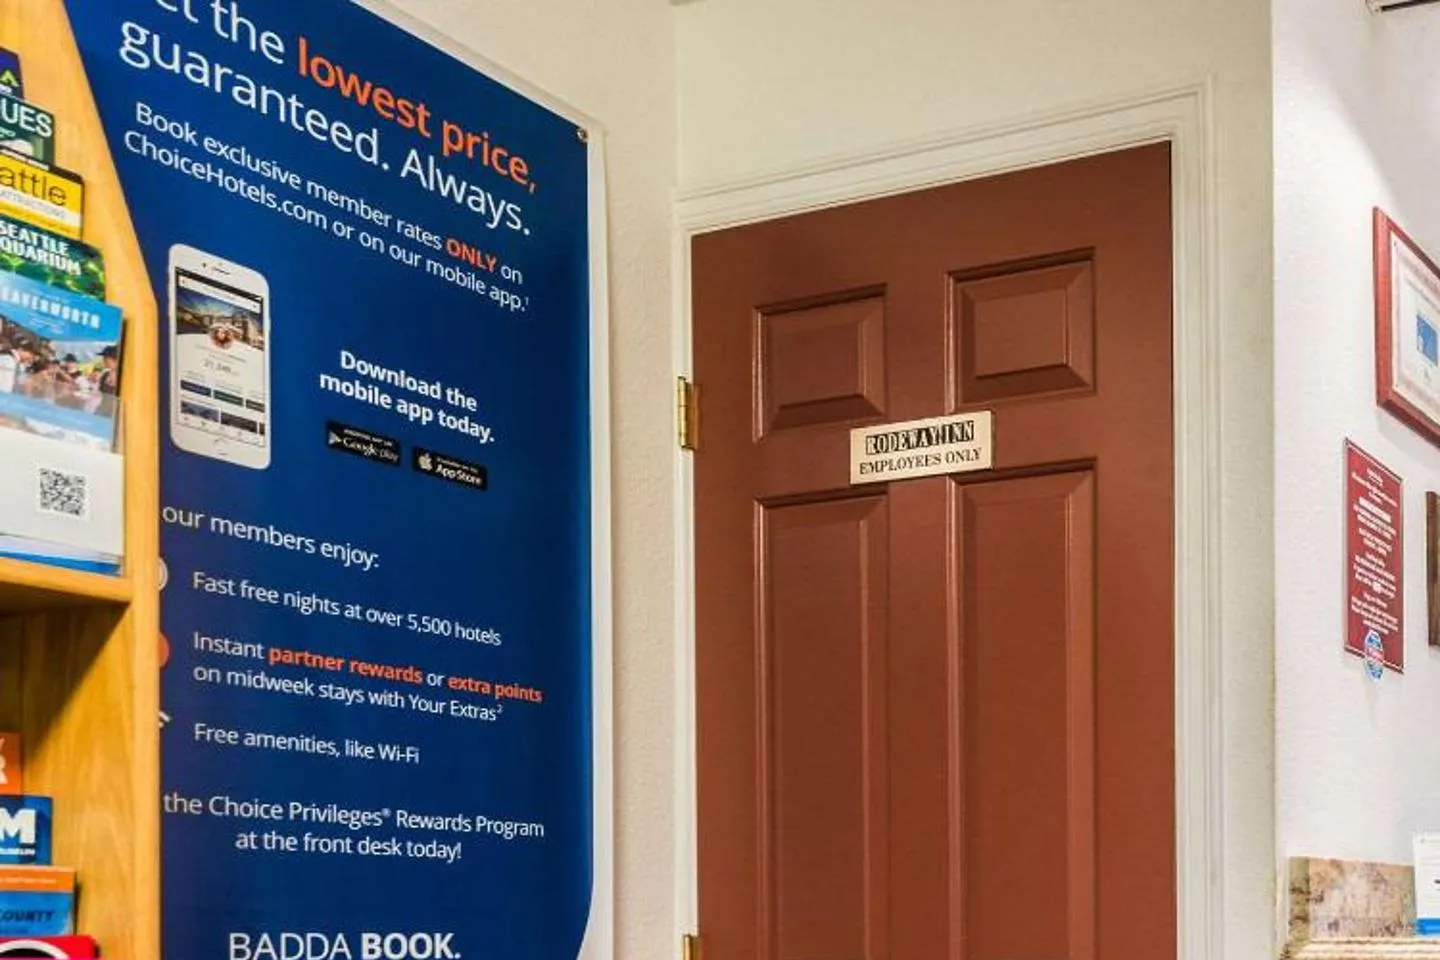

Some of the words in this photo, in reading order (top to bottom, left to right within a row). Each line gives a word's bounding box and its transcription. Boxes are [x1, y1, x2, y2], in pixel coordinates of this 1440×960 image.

[119, 20, 390, 171] guaranteed.
[401, 149, 532, 235] Always.
[210, 0, 286, 64] the
[298, 36, 431, 138] lowest
[442, 119, 538, 194] price,
[124, 130, 328, 232] ChoiceHotels.com
[333, 220, 355, 240] or
[359, 231, 385, 254] on
[389, 243, 422, 268] our
[425, 257, 486, 295] mobile
[136, 101, 198, 147] Book
[203, 136, 302, 191] exclusive
[306, 179, 392, 228] member
[397, 218, 442, 250] rates
[446, 237, 497, 272] ONLY
[501, 263, 523, 285] on
[319, 373, 392, 408] mobile
[396, 399, 433, 425] app
[438, 409, 495, 444] today.
[340, 350, 441, 400] Download
[446, 387, 477, 411] the
[860, 452, 941, 475] EMPLOYEES
[945, 447, 982, 464] ONLY
[865, 425, 941, 455] RODEWAY
[942, 420, 974, 444] INN
[163, 506, 205, 528] our
[210, 515, 315, 554] members
[320, 541, 380, 571] enjoy:
[193, 571, 236, 597] Fast
[240, 579, 279, 604] free
[283, 590, 340, 616] nights
[344, 604, 362, 619] at
[365, 608, 403, 627] over
[407, 613, 452, 637] 5,500
[454, 622, 502, 646] hotels
[193, 631, 265, 660] Instant
[268, 647, 345, 671] partner
[349, 658, 423, 684] rewards
[426, 671, 445, 687] or
[448, 675, 491, 694] extra
[495, 682, 543, 703] points
[193, 666, 221, 683] on
[226, 670, 314, 696] midweek
[318, 683, 364, 705] stays
[368, 689, 404, 708] with
[408, 694, 446, 715] Your
[194, 723, 238, 745] Free
[244, 731, 341, 757] amenities,
[345, 738, 375, 760] like
[377, 743, 420, 764] Wi-Fi
[163, 792, 203, 815] the
[209, 796, 283, 819] Choice
[396, 809, 471, 832] Rewards
[475, 815, 545, 840] Program
[235, 832, 258, 850] at
[263, 830, 298, 851] the
[303, 832, 353, 854] front
[357, 835, 402, 856] desk
[407, 839, 463, 863] today!
[361, 932, 461, 960] BOOK.
